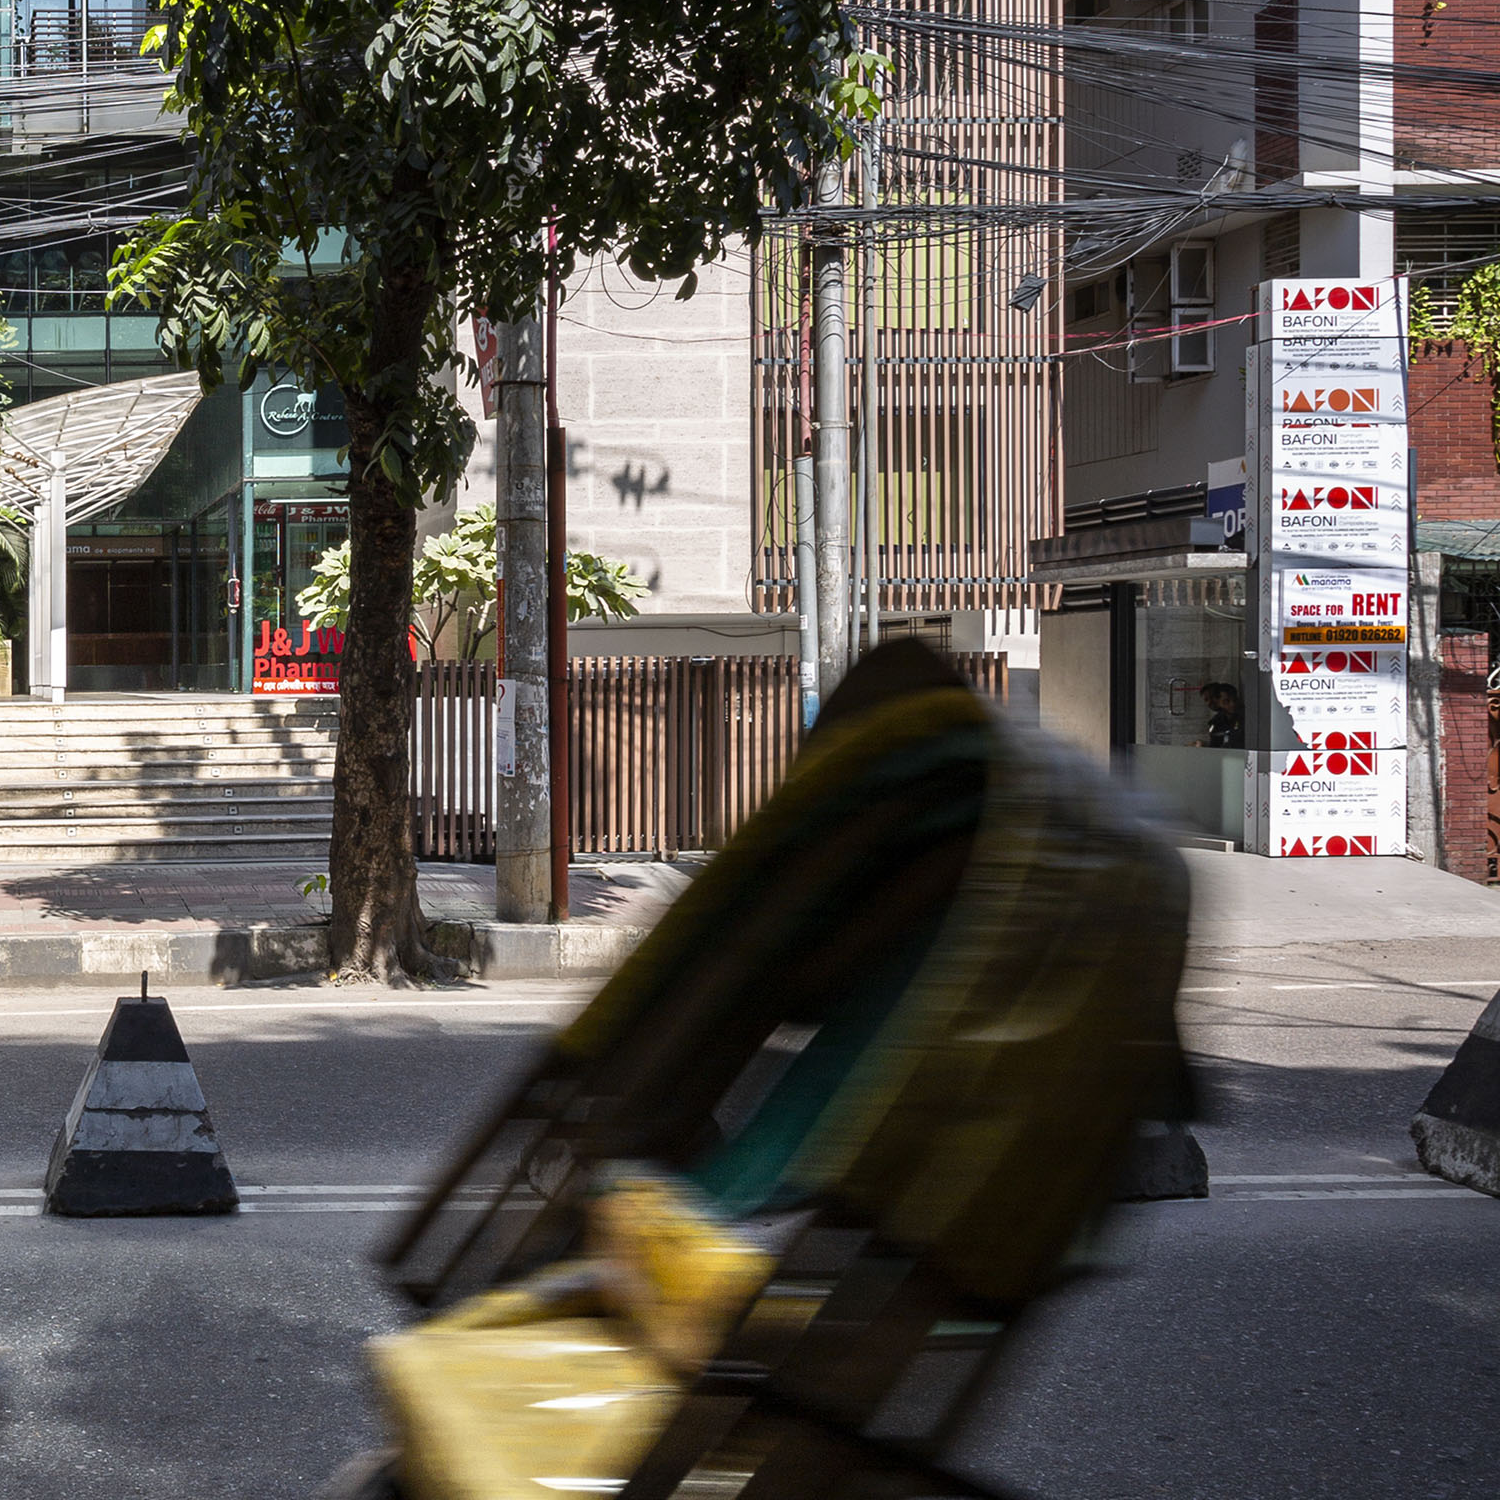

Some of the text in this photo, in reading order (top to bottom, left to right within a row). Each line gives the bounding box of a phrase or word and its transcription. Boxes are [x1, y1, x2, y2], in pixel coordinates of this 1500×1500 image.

[1283, 316, 1337, 327] BAFONI
[1281, 433, 1337, 445] BAFONI
[1281, 516, 1336, 527] BAFONI
[1291, 593, 1401, 616] SPACE FOR RENT
[1326, 629, 1358, 641] 01920
[1361, 628, 1401, 640] 626262
[1280, 679, 1335, 690] BAFONI
[1311, 731, 1377, 750] FONI
[1281, 752, 1378, 775] AFONI
[1281, 781, 1336, 792] BAFONI
